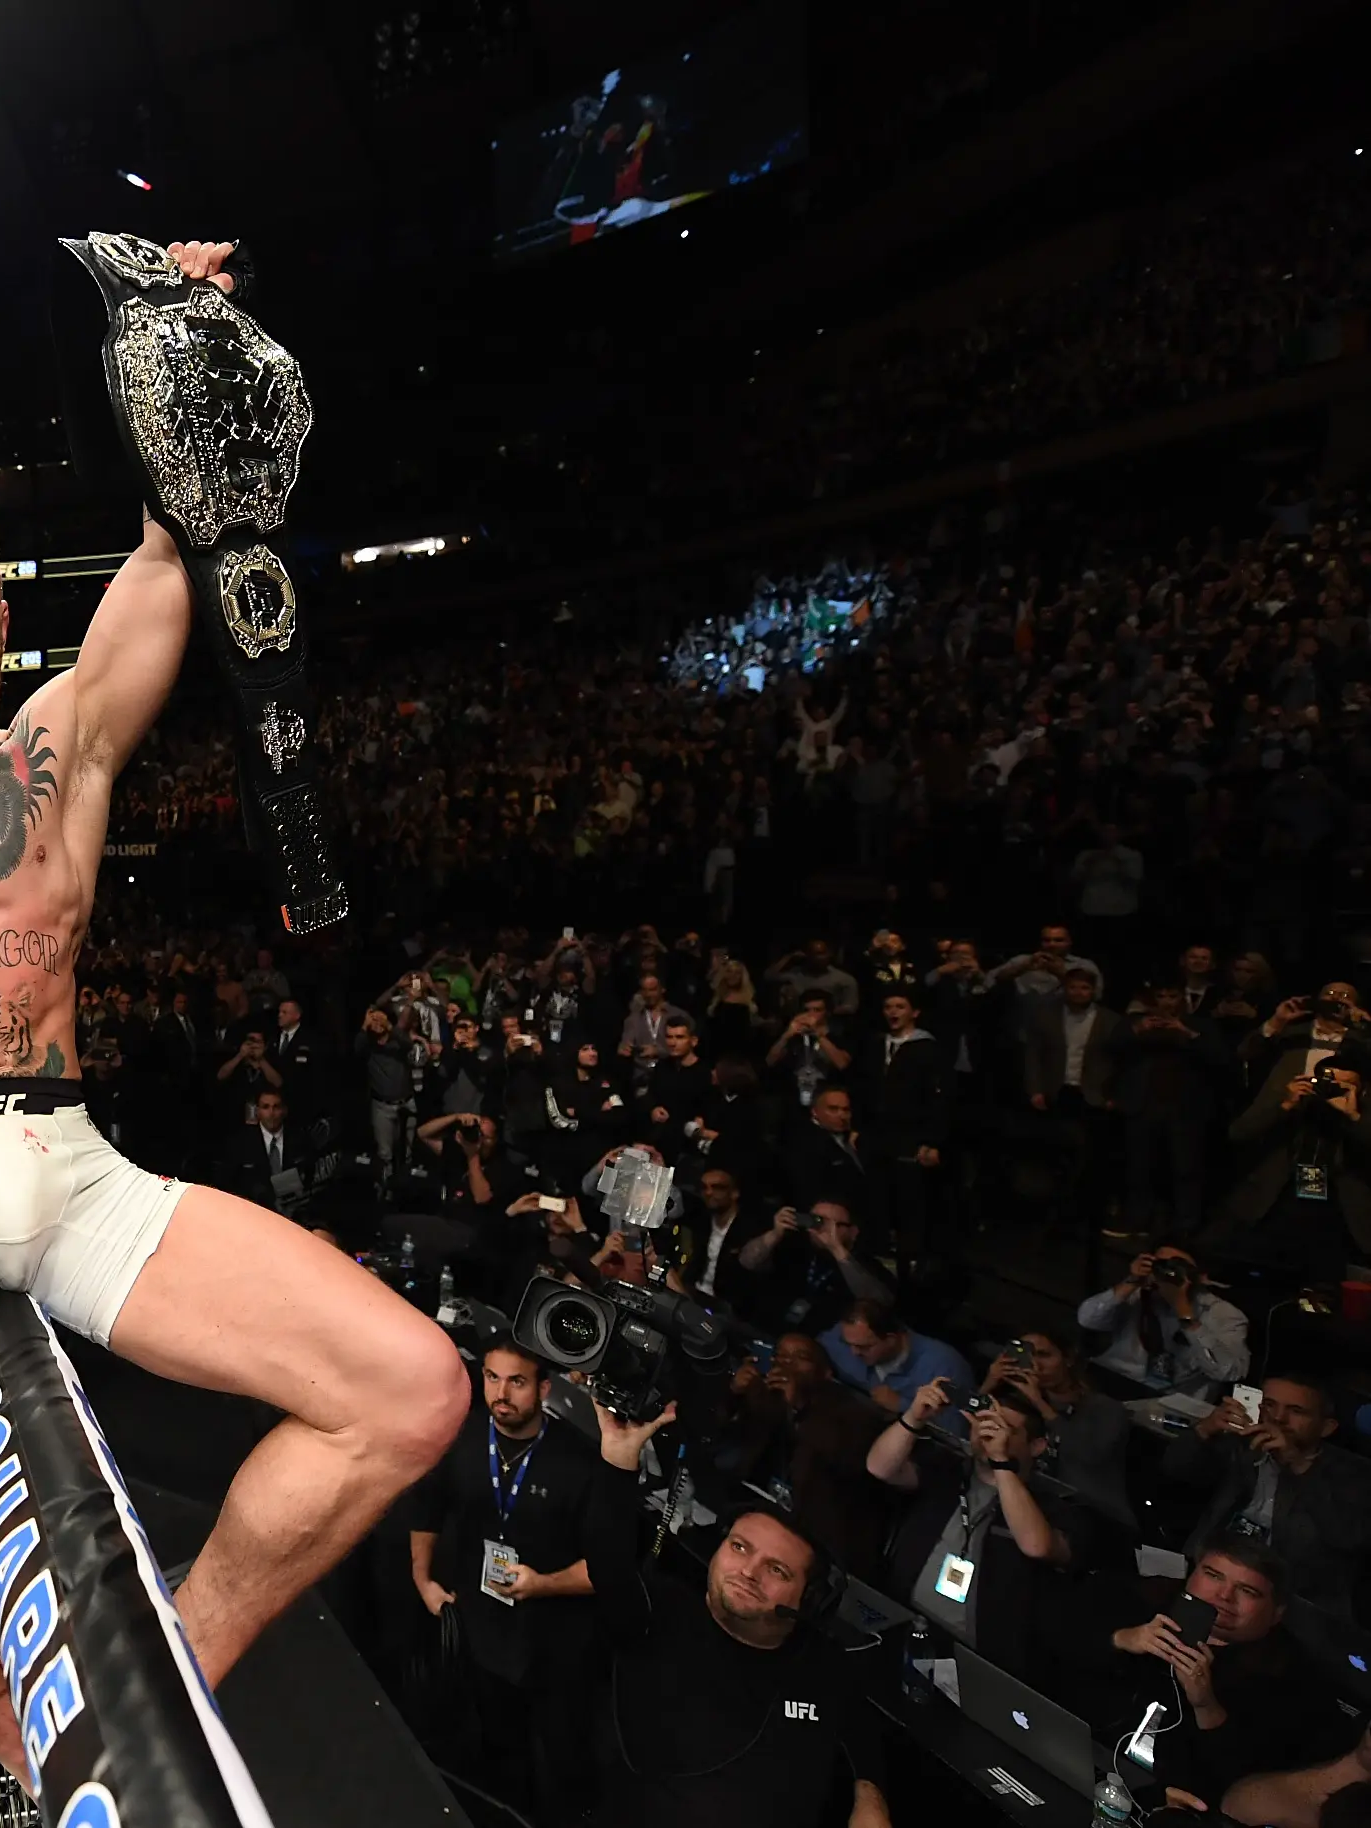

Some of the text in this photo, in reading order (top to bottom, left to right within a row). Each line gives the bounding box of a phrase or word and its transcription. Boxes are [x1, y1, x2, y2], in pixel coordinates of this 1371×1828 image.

[0, 563, 18, 578] FC
[1, 654, 20, 672] FC
[117, 843, 157, 857] LIGHT
[784, 1700, 819, 1721] UFC
